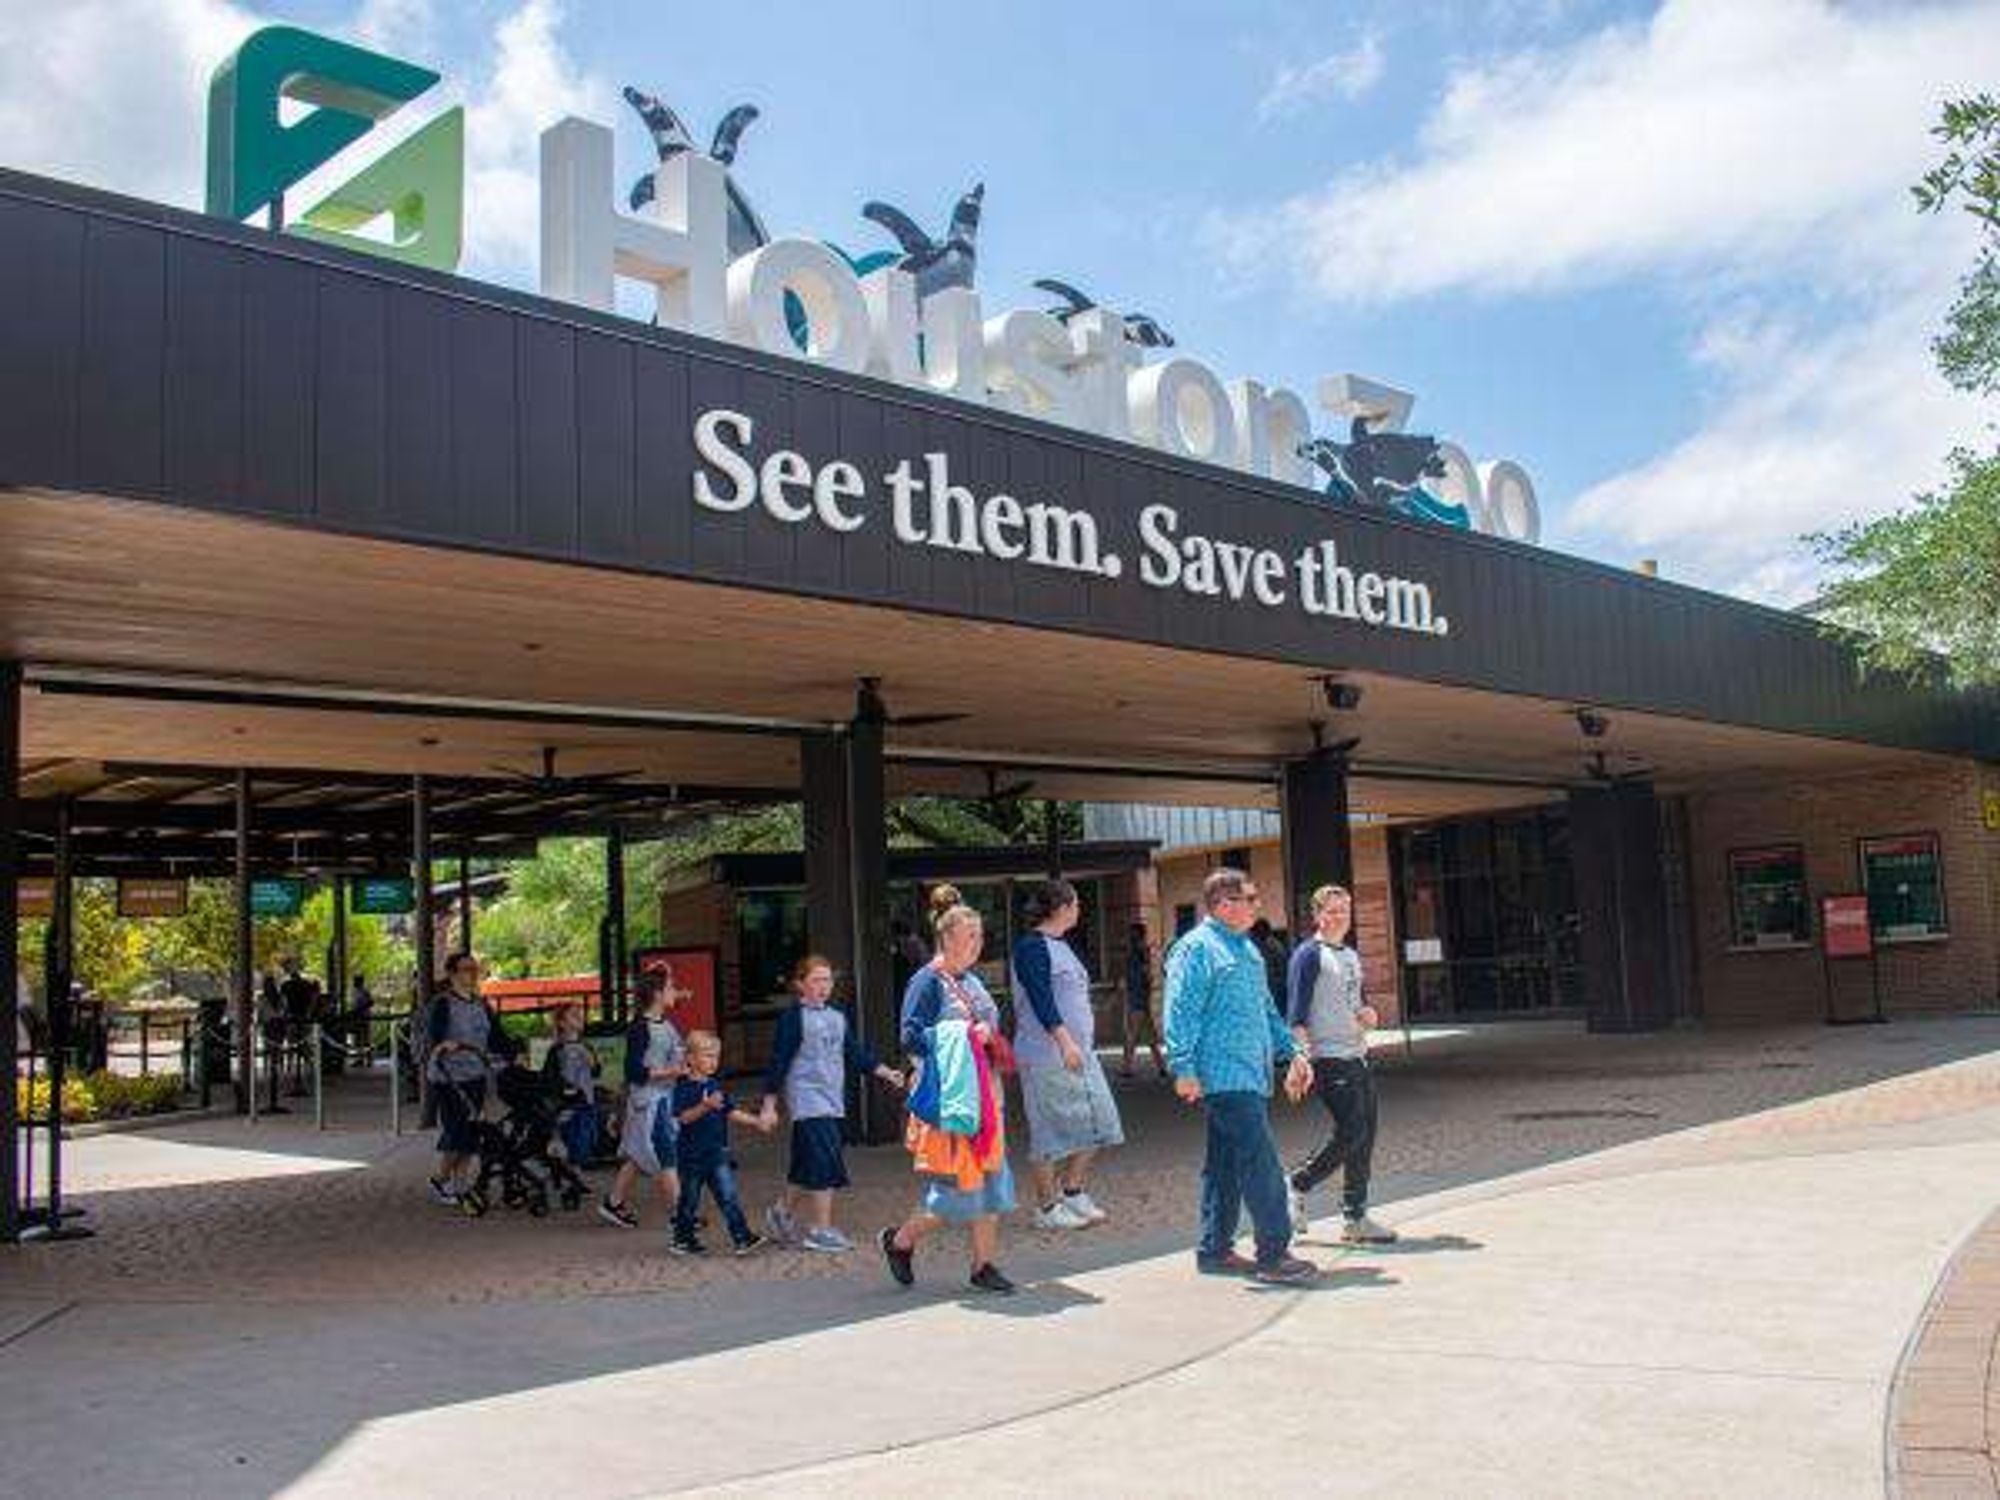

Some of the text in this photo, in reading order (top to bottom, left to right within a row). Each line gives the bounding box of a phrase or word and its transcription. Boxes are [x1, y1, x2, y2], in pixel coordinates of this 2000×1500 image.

[540, 116, 1314, 488] Houston
[693, 409, 1450, 636] See them. Save them.
